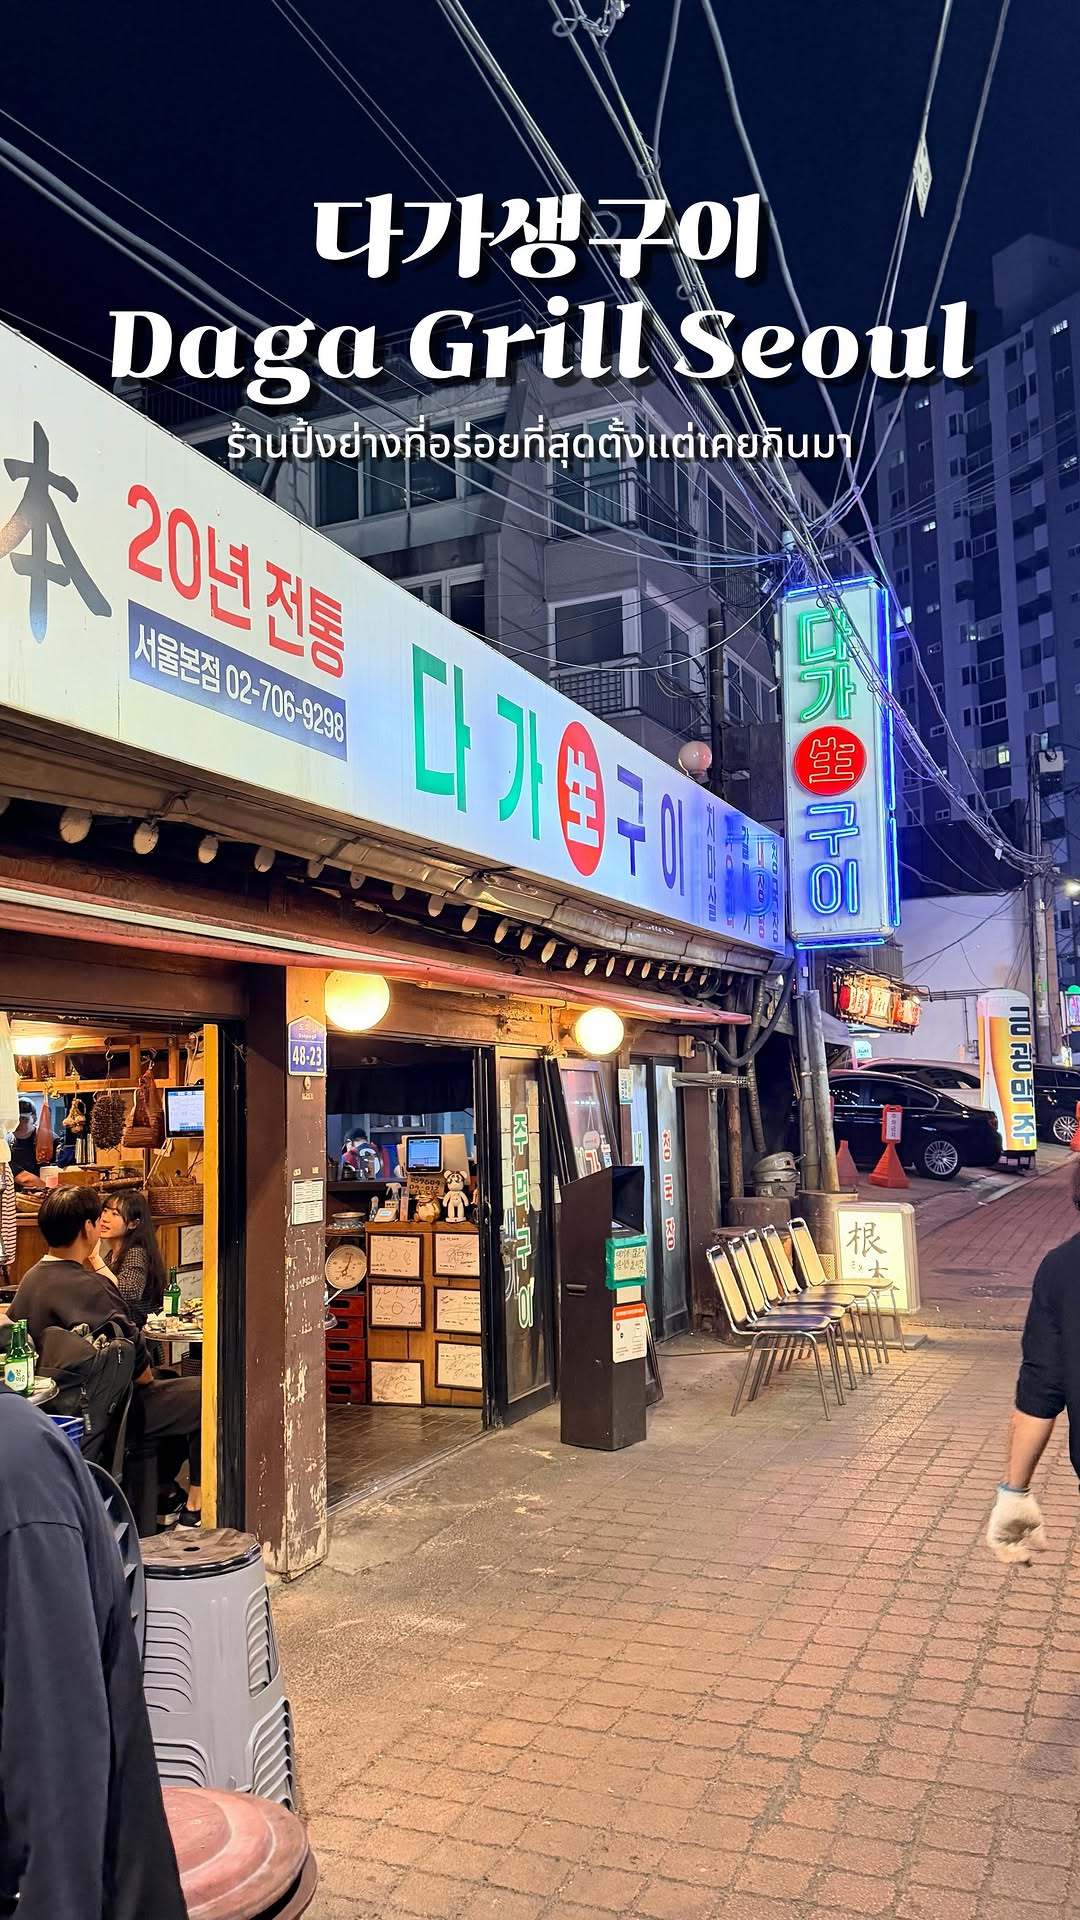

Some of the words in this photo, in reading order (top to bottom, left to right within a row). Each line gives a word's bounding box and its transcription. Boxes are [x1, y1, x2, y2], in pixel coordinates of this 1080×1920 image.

[0, 420, 113, 644] 本
[128, 485, 250, 629] 20년
[266, 562, 343, 677] 전통
[134, 623, 221, 694] 서울본점
[224, 663, 346, 744] 02-706-9298
[706, 802, 717, 923] 치마살
[292, 1045, 322, 1067] 48-23
[513, 1113, 535, 1329] 주먹구이
[662, 1129, 676, 1251] 청국장
